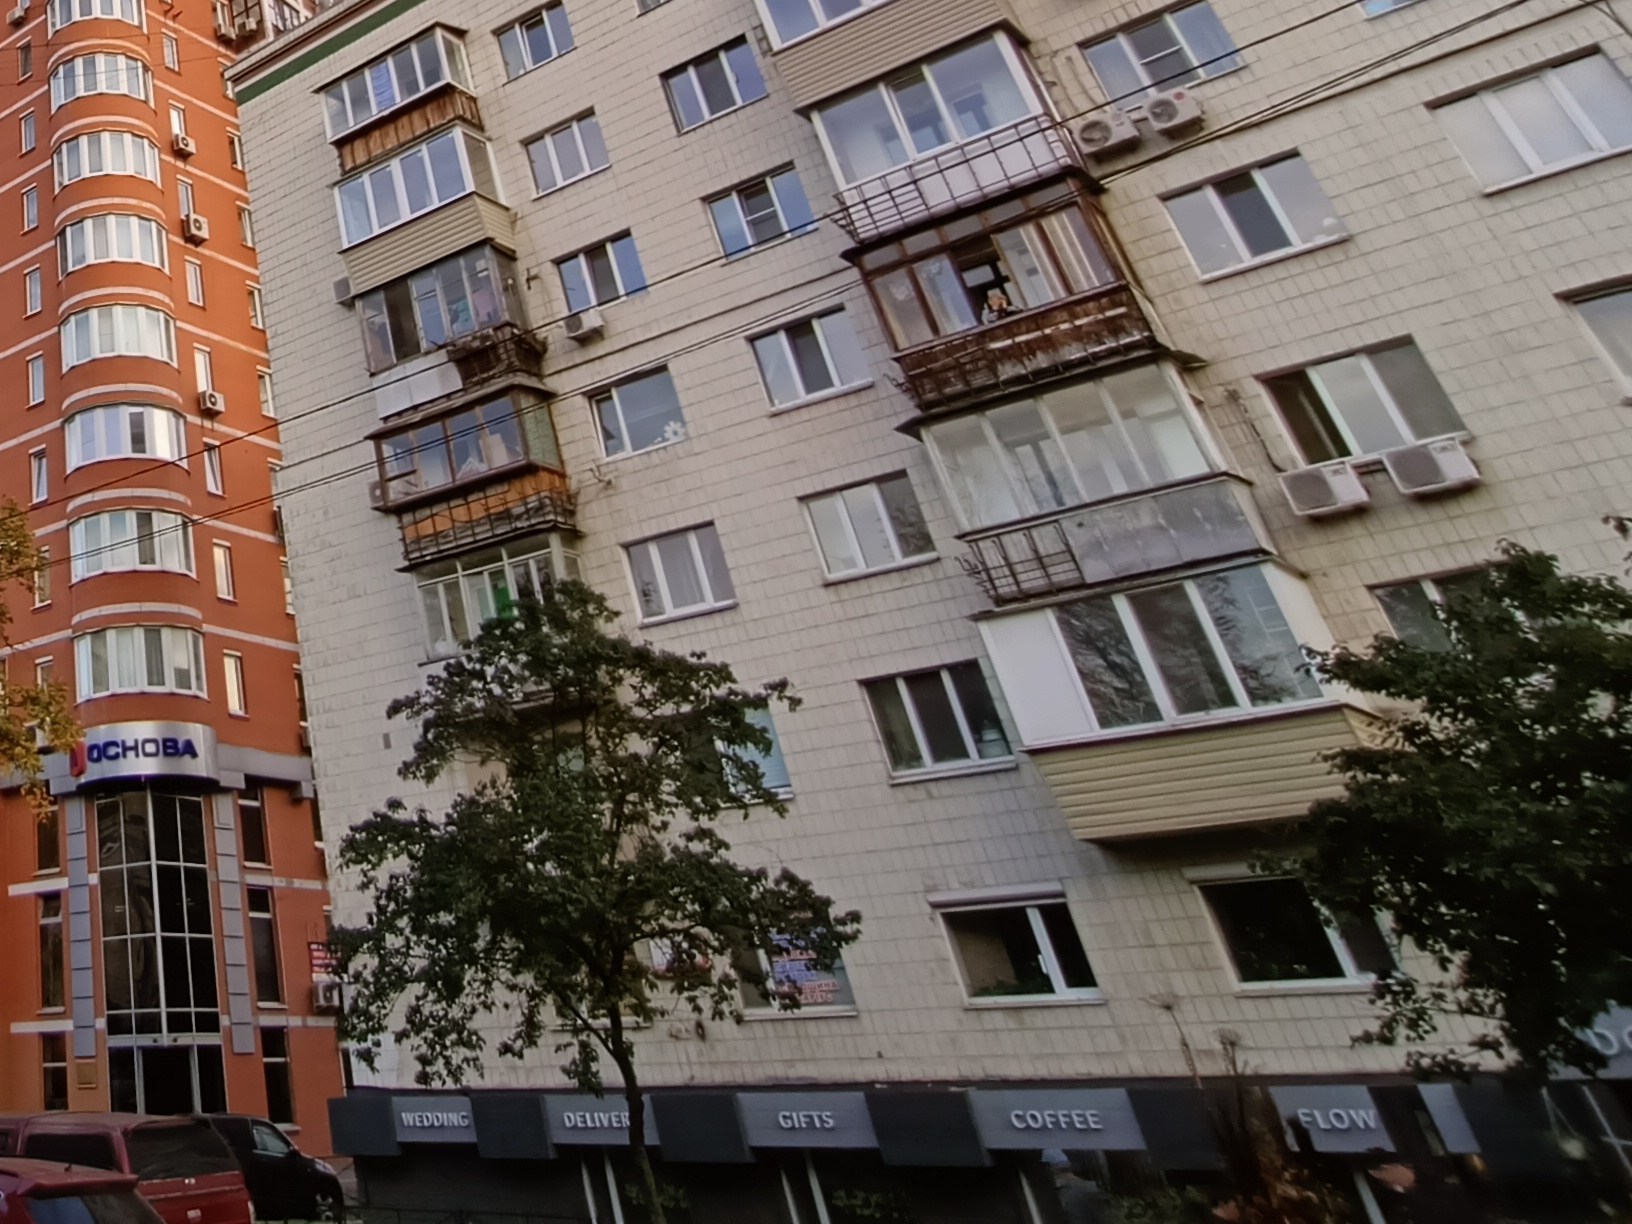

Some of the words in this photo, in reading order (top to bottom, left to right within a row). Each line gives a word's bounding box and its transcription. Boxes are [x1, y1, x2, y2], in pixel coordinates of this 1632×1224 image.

[87, 738, 198, 763] ОСНОВА
[401, 1111, 469, 1127] WEDDING
[563, 1111, 631, 1128] DELIVER
[778, 1111, 834, 1128] GIFTS
[1011, 1110, 1103, 1129] COFFEE
[1297, 1108, 1377, 1130] FLOW
